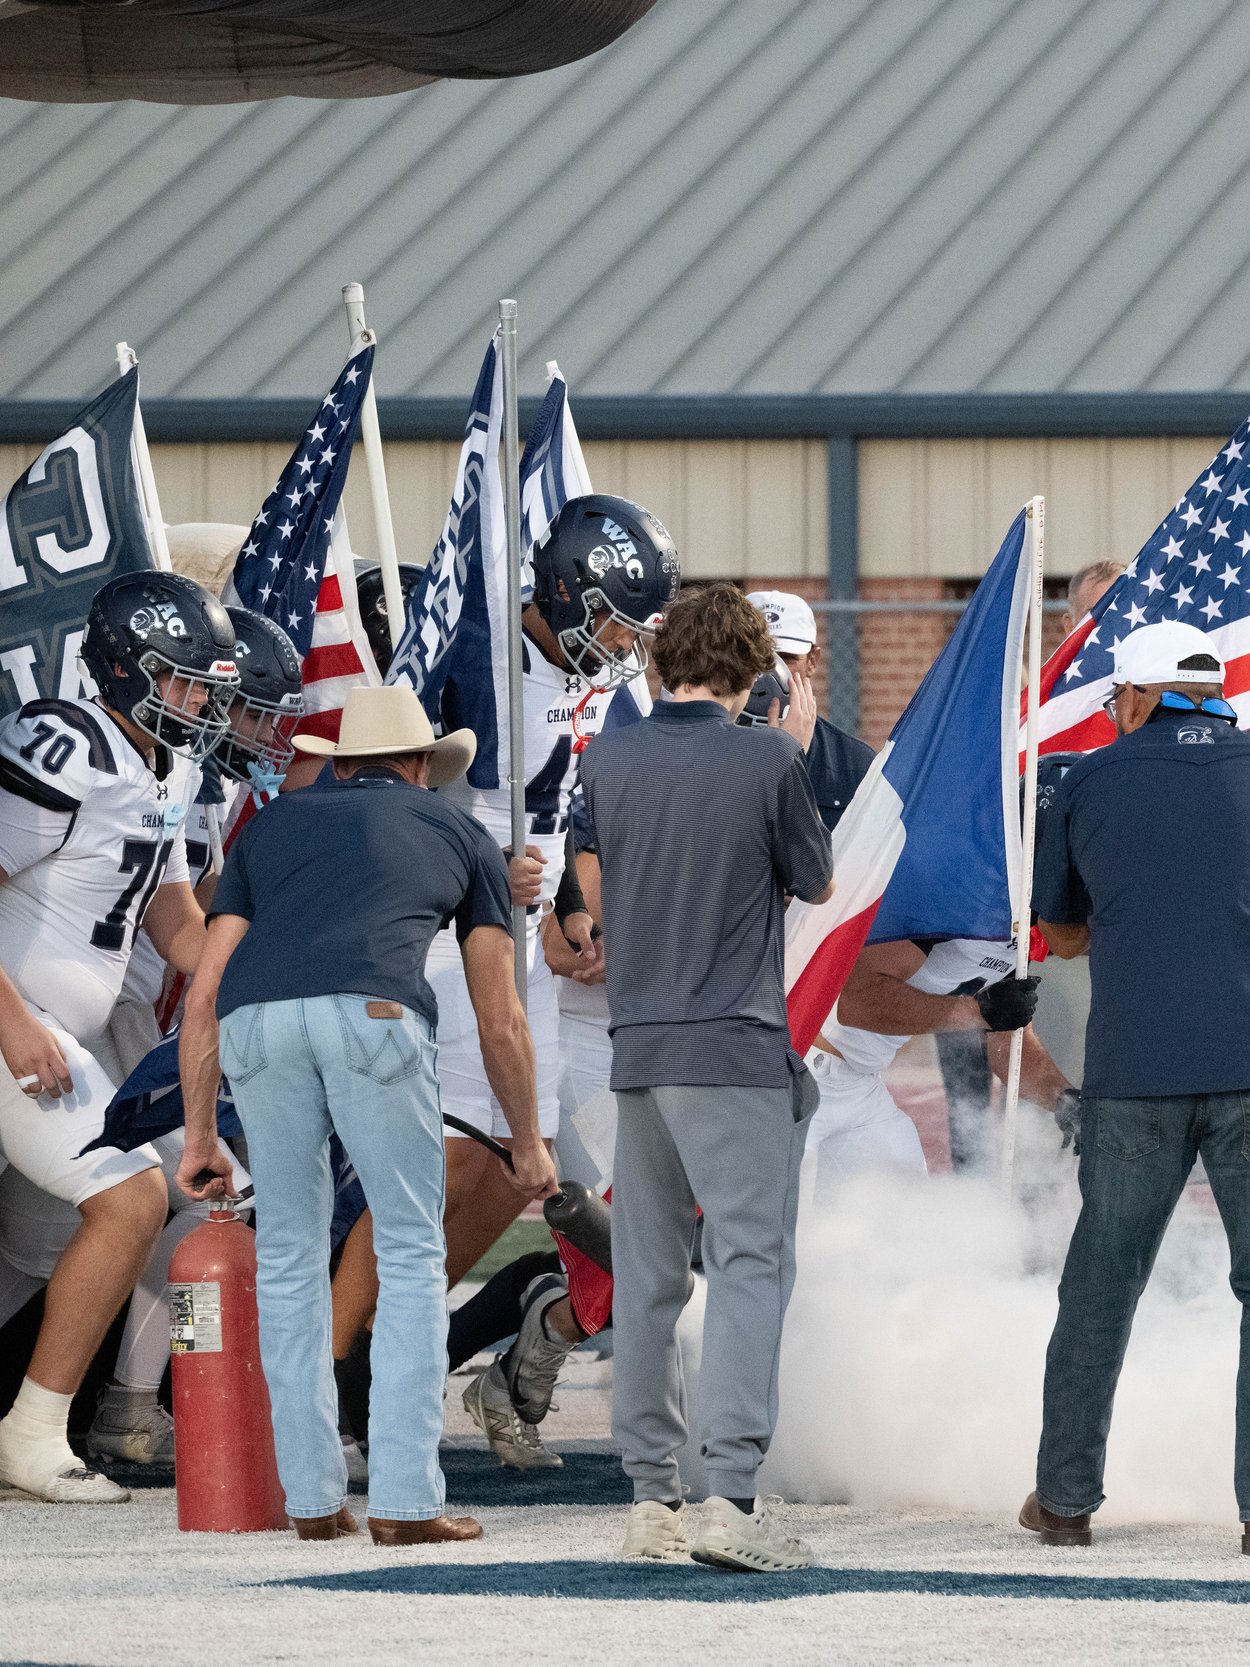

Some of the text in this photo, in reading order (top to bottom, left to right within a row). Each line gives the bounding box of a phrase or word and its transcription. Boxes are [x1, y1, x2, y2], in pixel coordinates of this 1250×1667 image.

[602, 517, 644, 580] WAC
[547, 706, 597, 723] CHAMION
[20, 721, 77, 776] 70
[142, 813, 165, 828] CHAM
[979, 956, 1013, 974] CHAMPION
